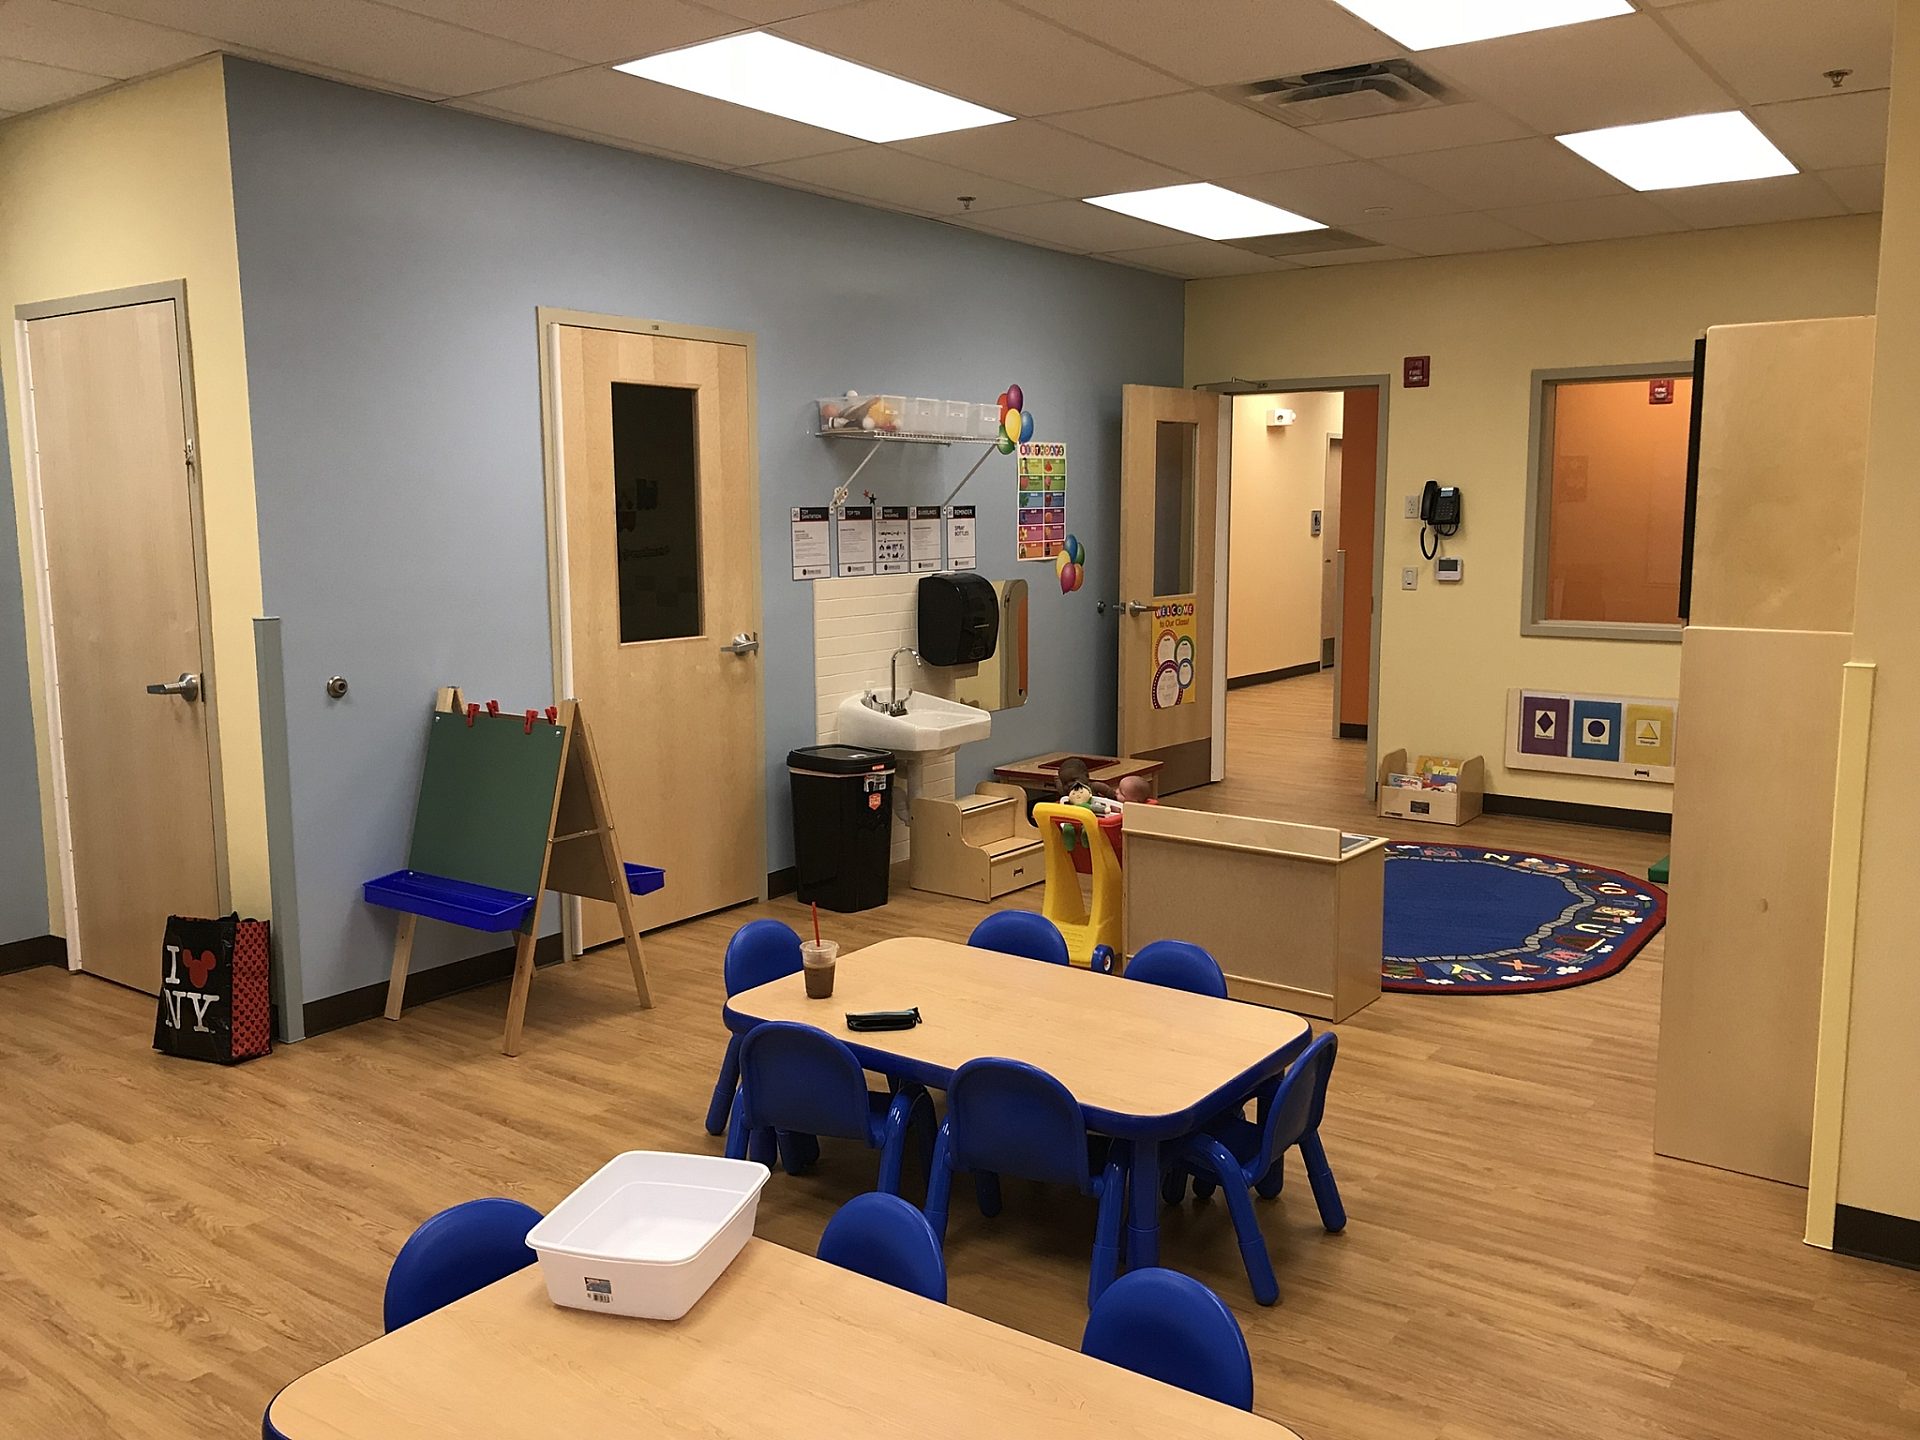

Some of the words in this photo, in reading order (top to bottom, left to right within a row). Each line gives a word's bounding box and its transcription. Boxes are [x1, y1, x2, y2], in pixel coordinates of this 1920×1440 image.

[1155, 603, 1194, 619] WELCOME
[165, 944, 181, 985] I
[163, 987, 220, 1033] NY
